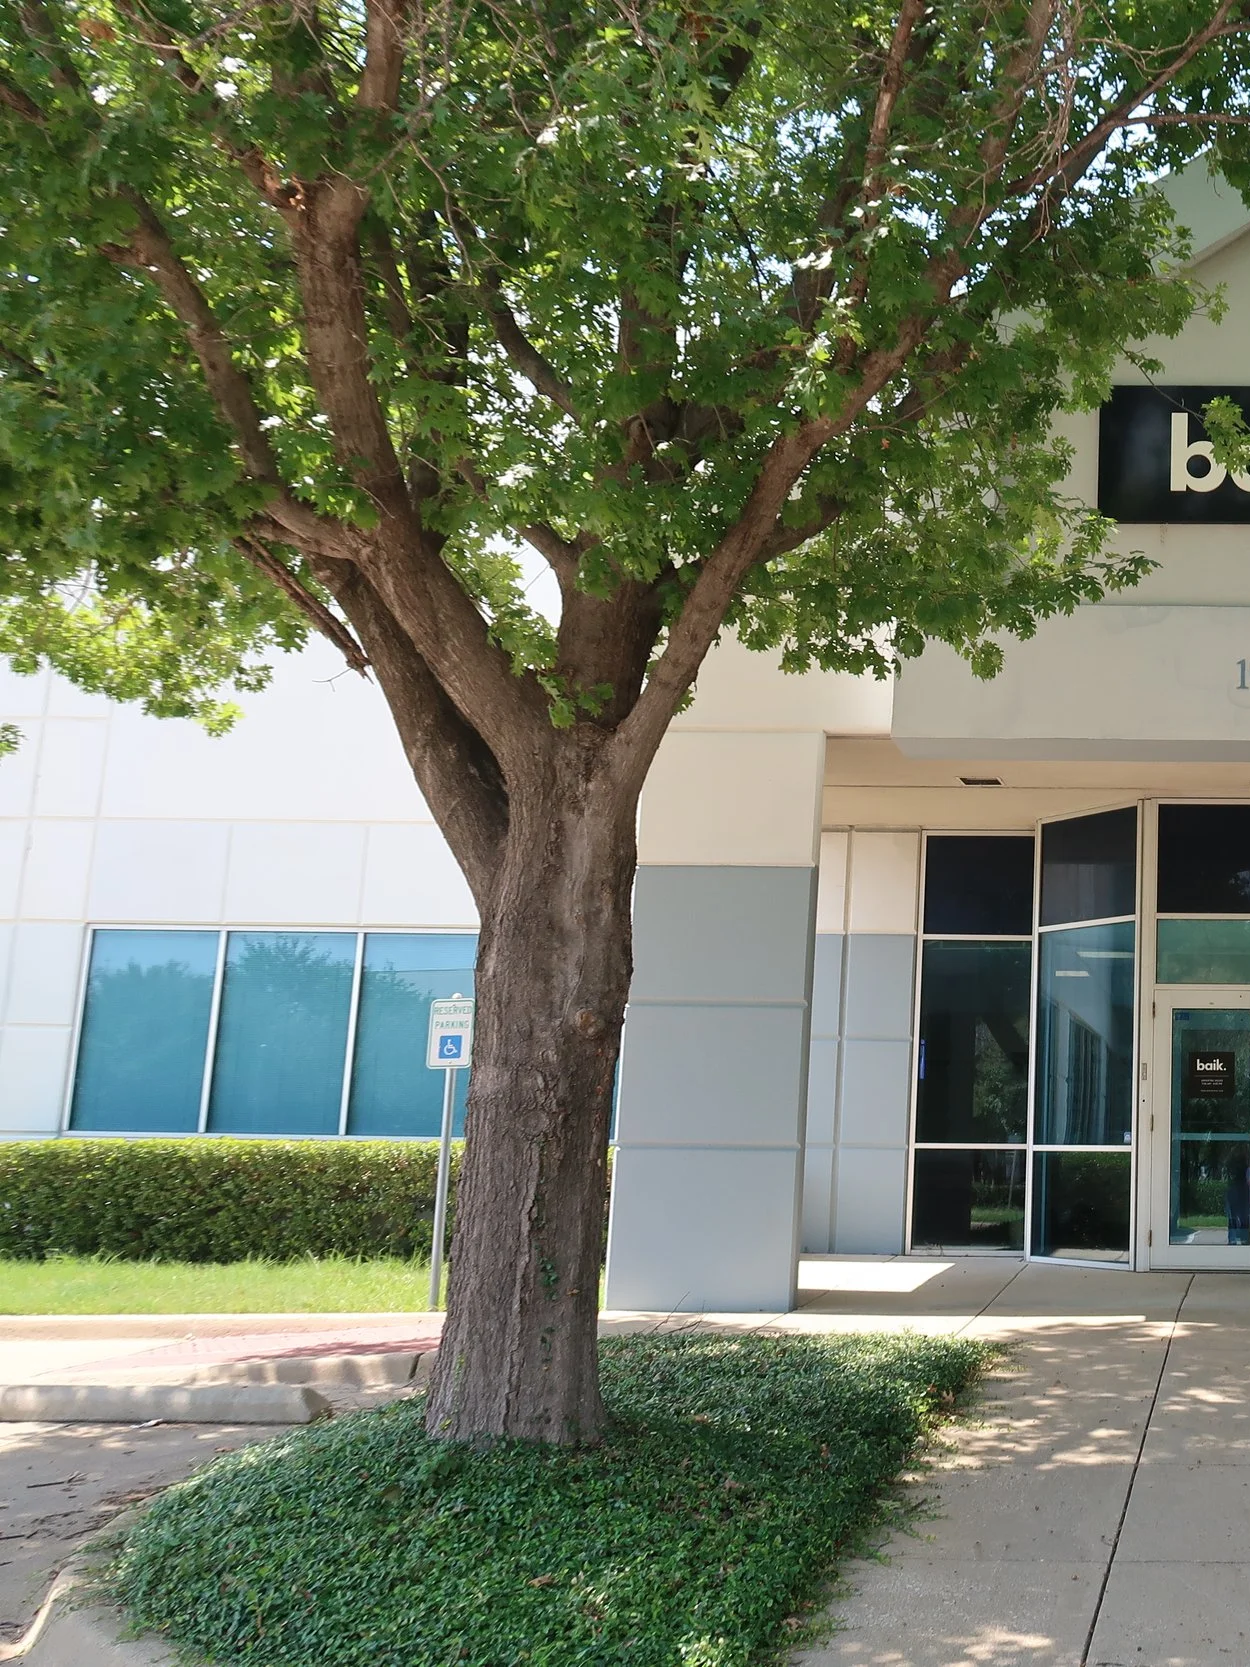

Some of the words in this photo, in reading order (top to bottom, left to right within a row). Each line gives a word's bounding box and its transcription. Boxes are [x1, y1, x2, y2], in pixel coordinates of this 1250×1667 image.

[434, 1005, 473, 1015] RESERVED
[434, 1020, 470, 1029] PARKING
[1196, 1058, 1227, 1071] baik.
